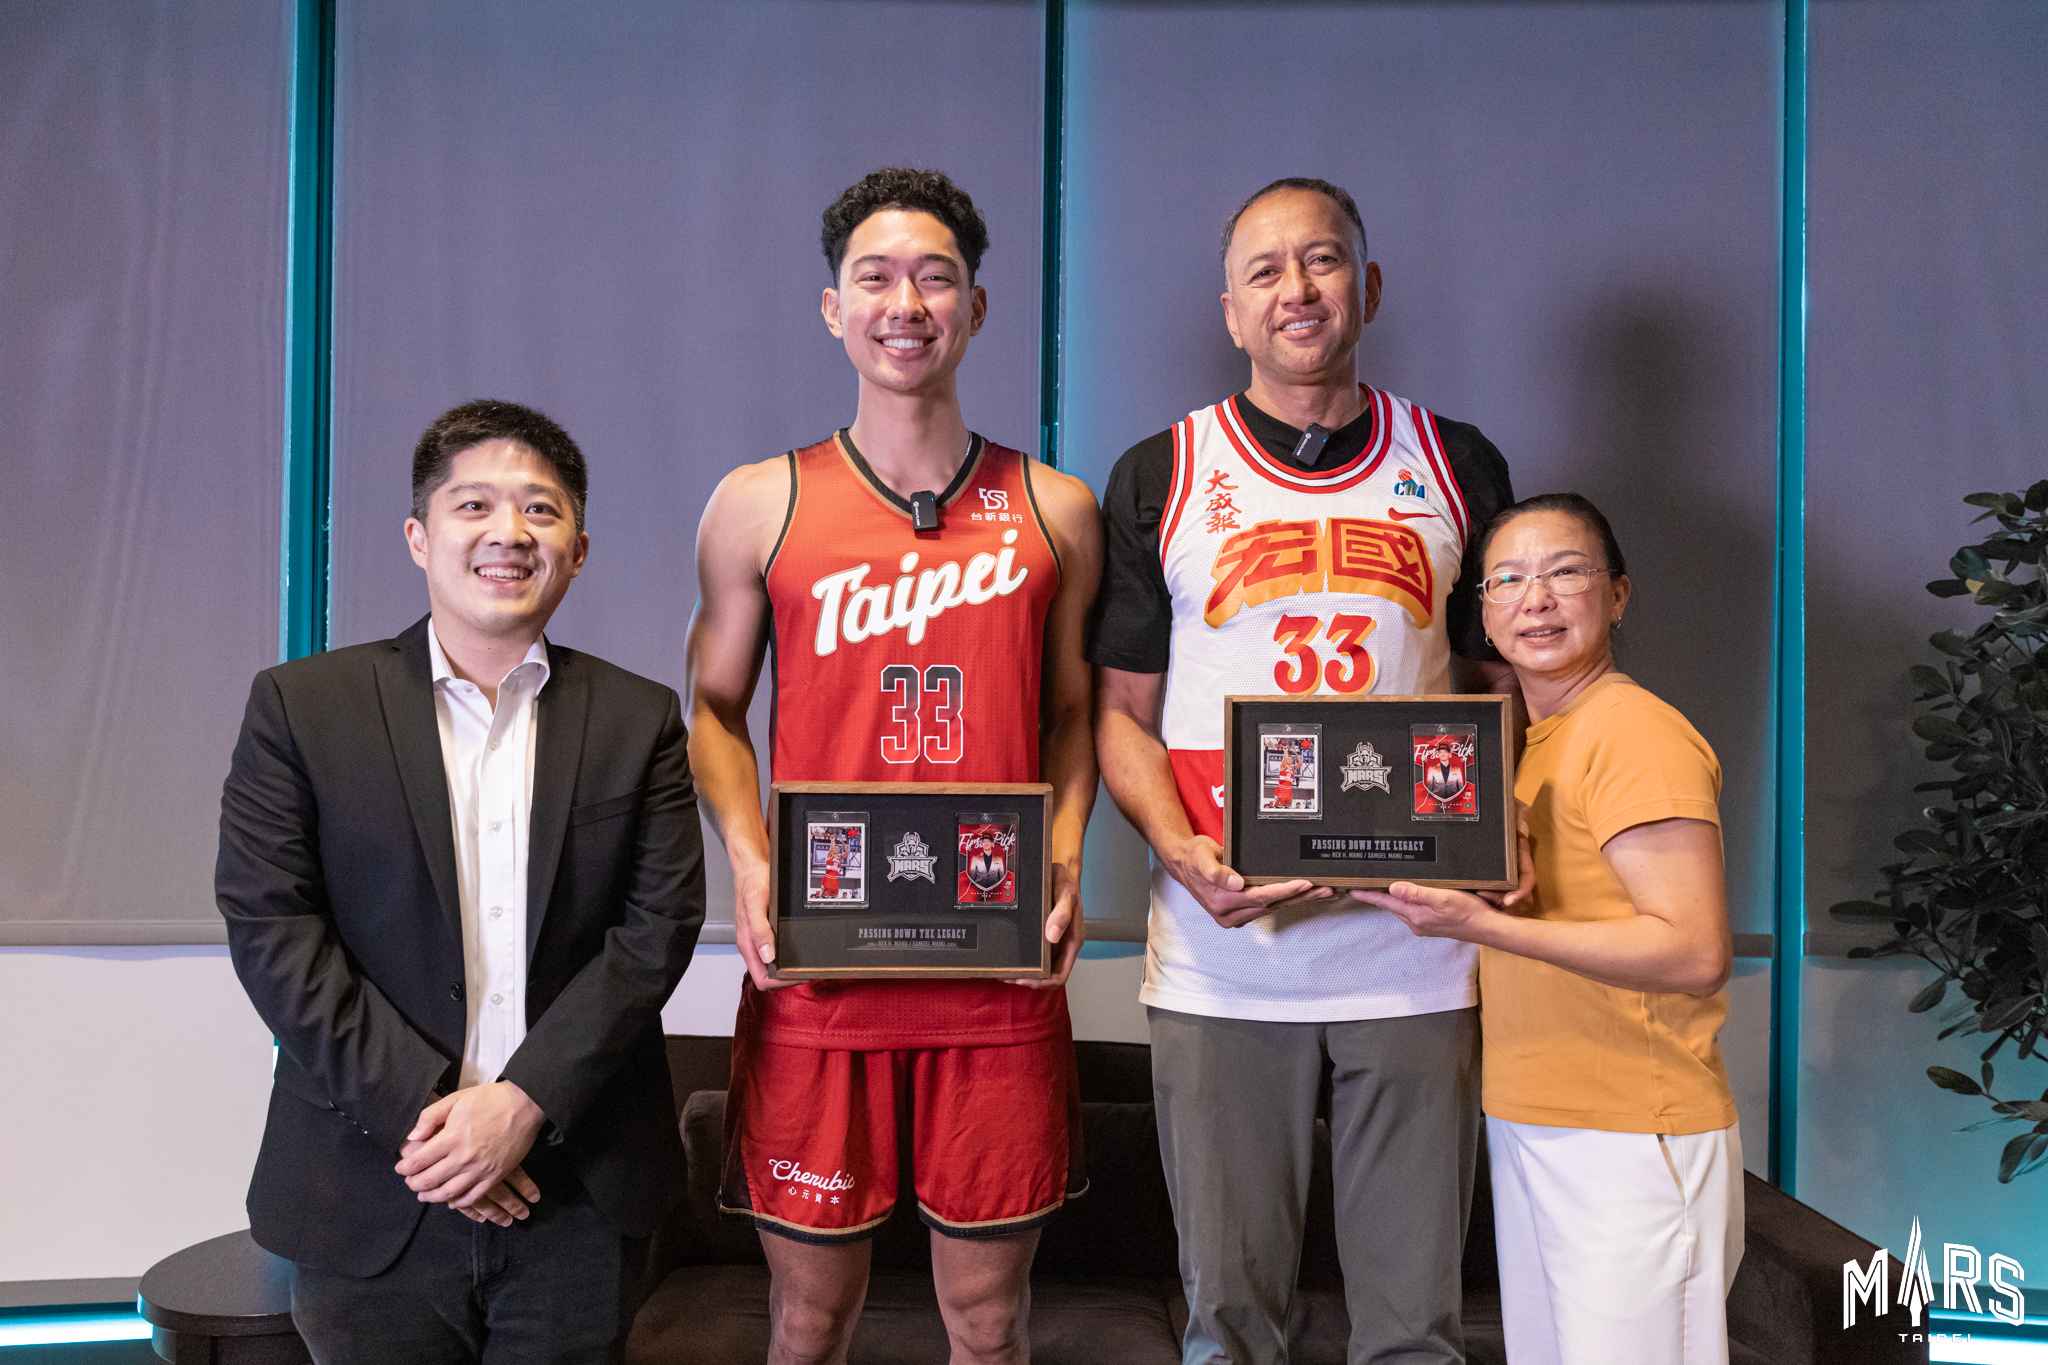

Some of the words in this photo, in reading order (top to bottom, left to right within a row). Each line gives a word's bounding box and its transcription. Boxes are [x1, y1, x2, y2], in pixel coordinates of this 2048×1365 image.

[1394, 482, 1426, 499] CBA
[1204, 469, 1242, 534] 大成報
[970, 511, 1024, 524] 台新銀行
[1203, 516, 1435, 630] 宏國
[811, 528, 1030, 657] Taipei
[1273, 612, 1377, 696] 33
[880, 664, 964, 764] 33
[1345, 769, 1386, 787] MARS
[1311, 839, 1346, 850] PASSING
[1348, 840, 1372, 850] DOWN
[1374, 840, 1391, 851] THE
[1393, 840, 1425, 851] LEGACY
[892, 859, 931, 876] MARS
[858, 928, 892, 939] PASSING
[894, 928, 917, 939] DOWN
[919, 928, 935, 939] THE
[937, 928, 967, 939] LEGACY
[768, 1158, 856, 1191] Cherubic
[787, 1185, 840, 1205] 心元資本
